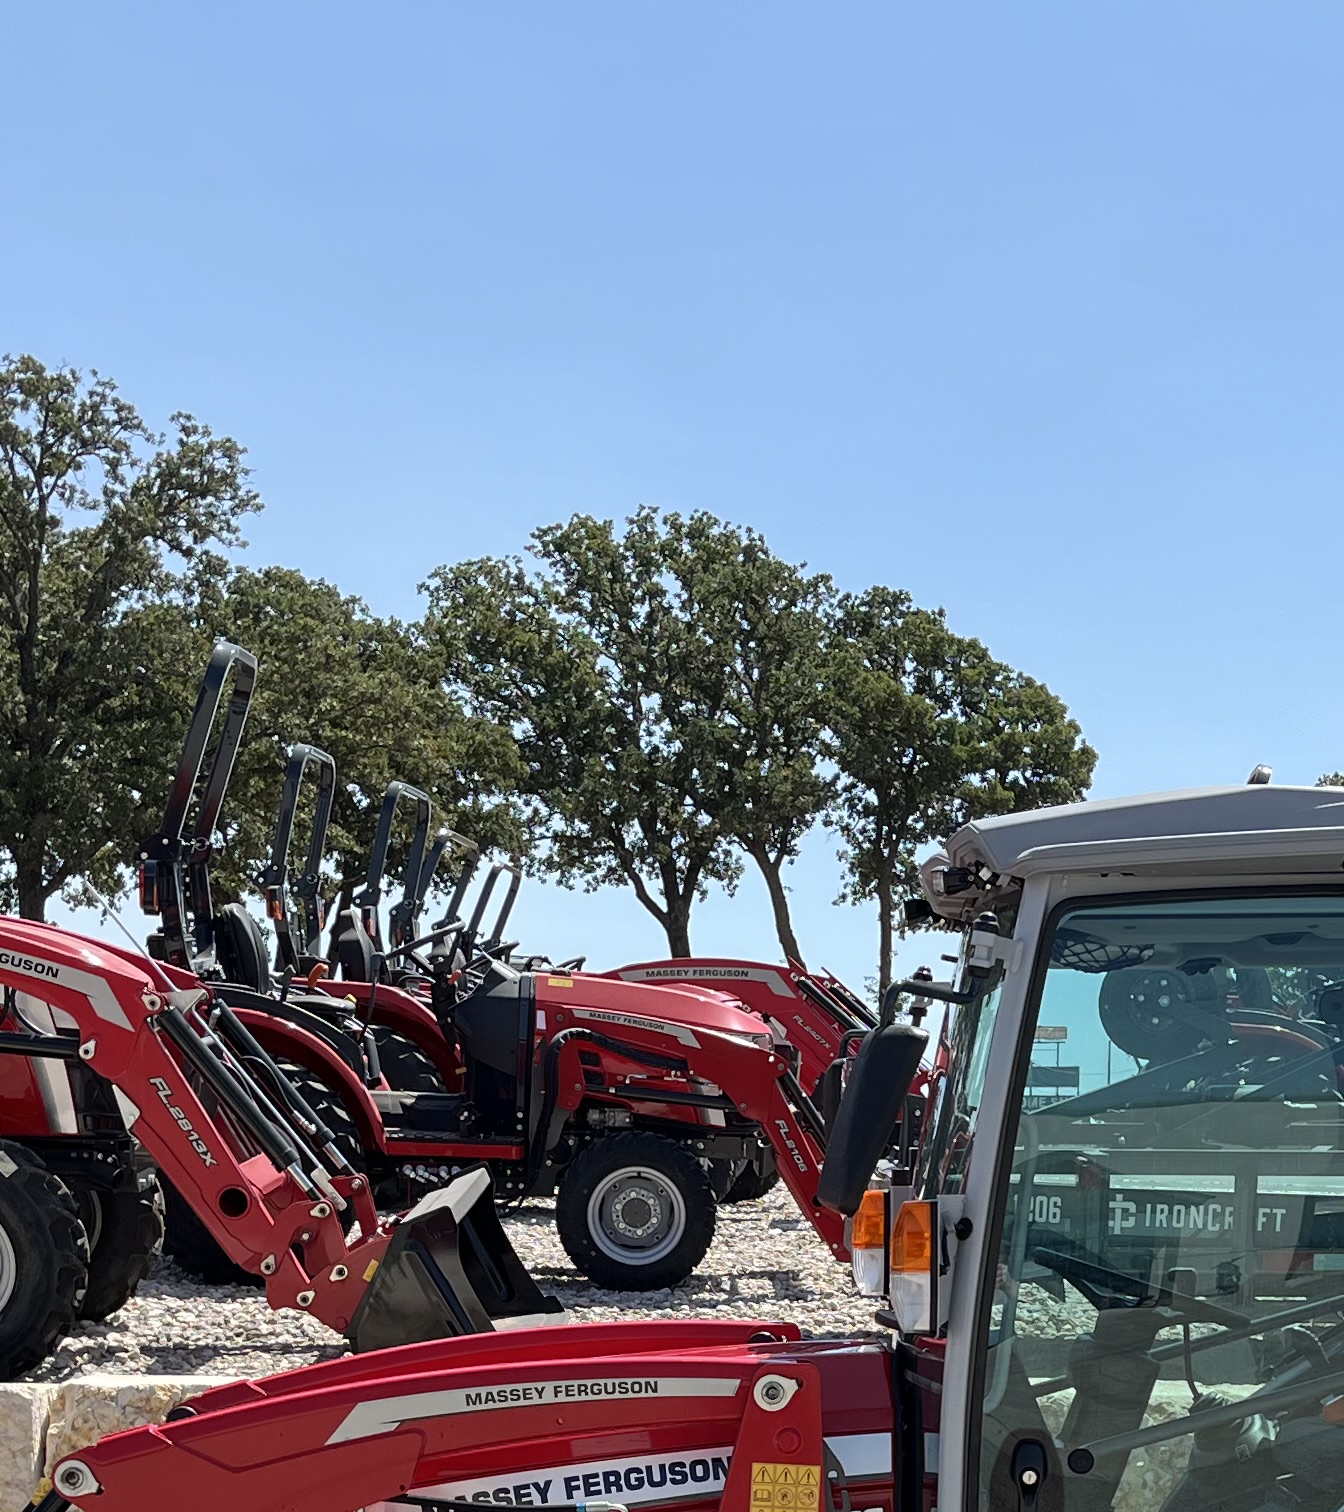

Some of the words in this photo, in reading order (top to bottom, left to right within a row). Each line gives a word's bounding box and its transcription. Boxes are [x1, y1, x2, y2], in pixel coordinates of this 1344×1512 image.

[646, 969, 690, 978] MASSEY
[692, 969, 749, 978] FERGUSON
[589, 1012, 622, 1022] MASSEY
[623, 1017, 665, 1031] FERGUSON
[148, 1076, 218, 1168] FL.2813X
[1144, 1203, 1287, 1232] IRONCRFT
[464, 1386, 546, 1407] MASSEY
[553, 1380, 658, 1398] FERGUSON
[563, 1456, 733, 1501] FERGUSON
